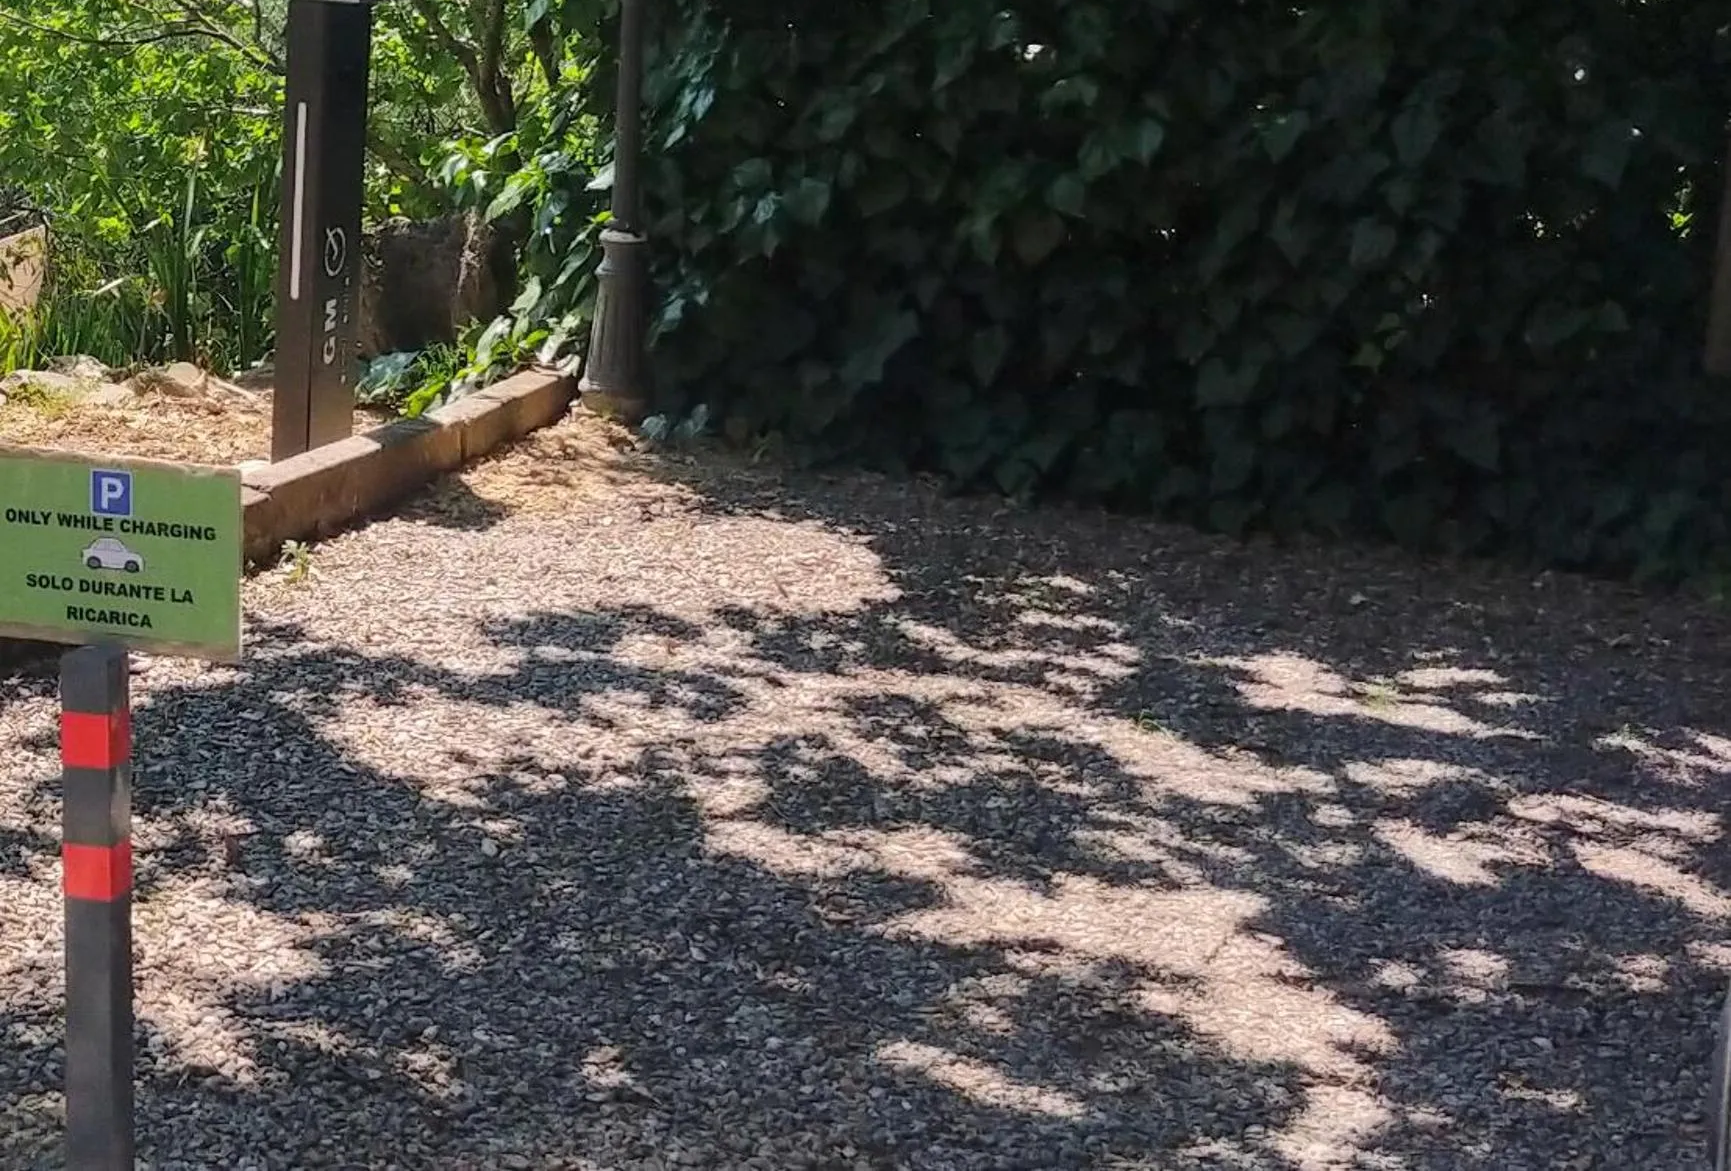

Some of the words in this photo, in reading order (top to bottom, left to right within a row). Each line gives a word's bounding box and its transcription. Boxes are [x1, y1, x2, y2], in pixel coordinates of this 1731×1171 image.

[100, 477, 124, 509] P
[5, 508, 52, 525] ONLY
[57, 513, 114, 531] WHILE
[119, 520, 216, 541] CHARGING
[26, 574, 73, 591] SOLO
[79, 579, 165, 601] DURANTE
[171, 588, 194, 604] LA
[66, 605, 153, 628] RICARICA
